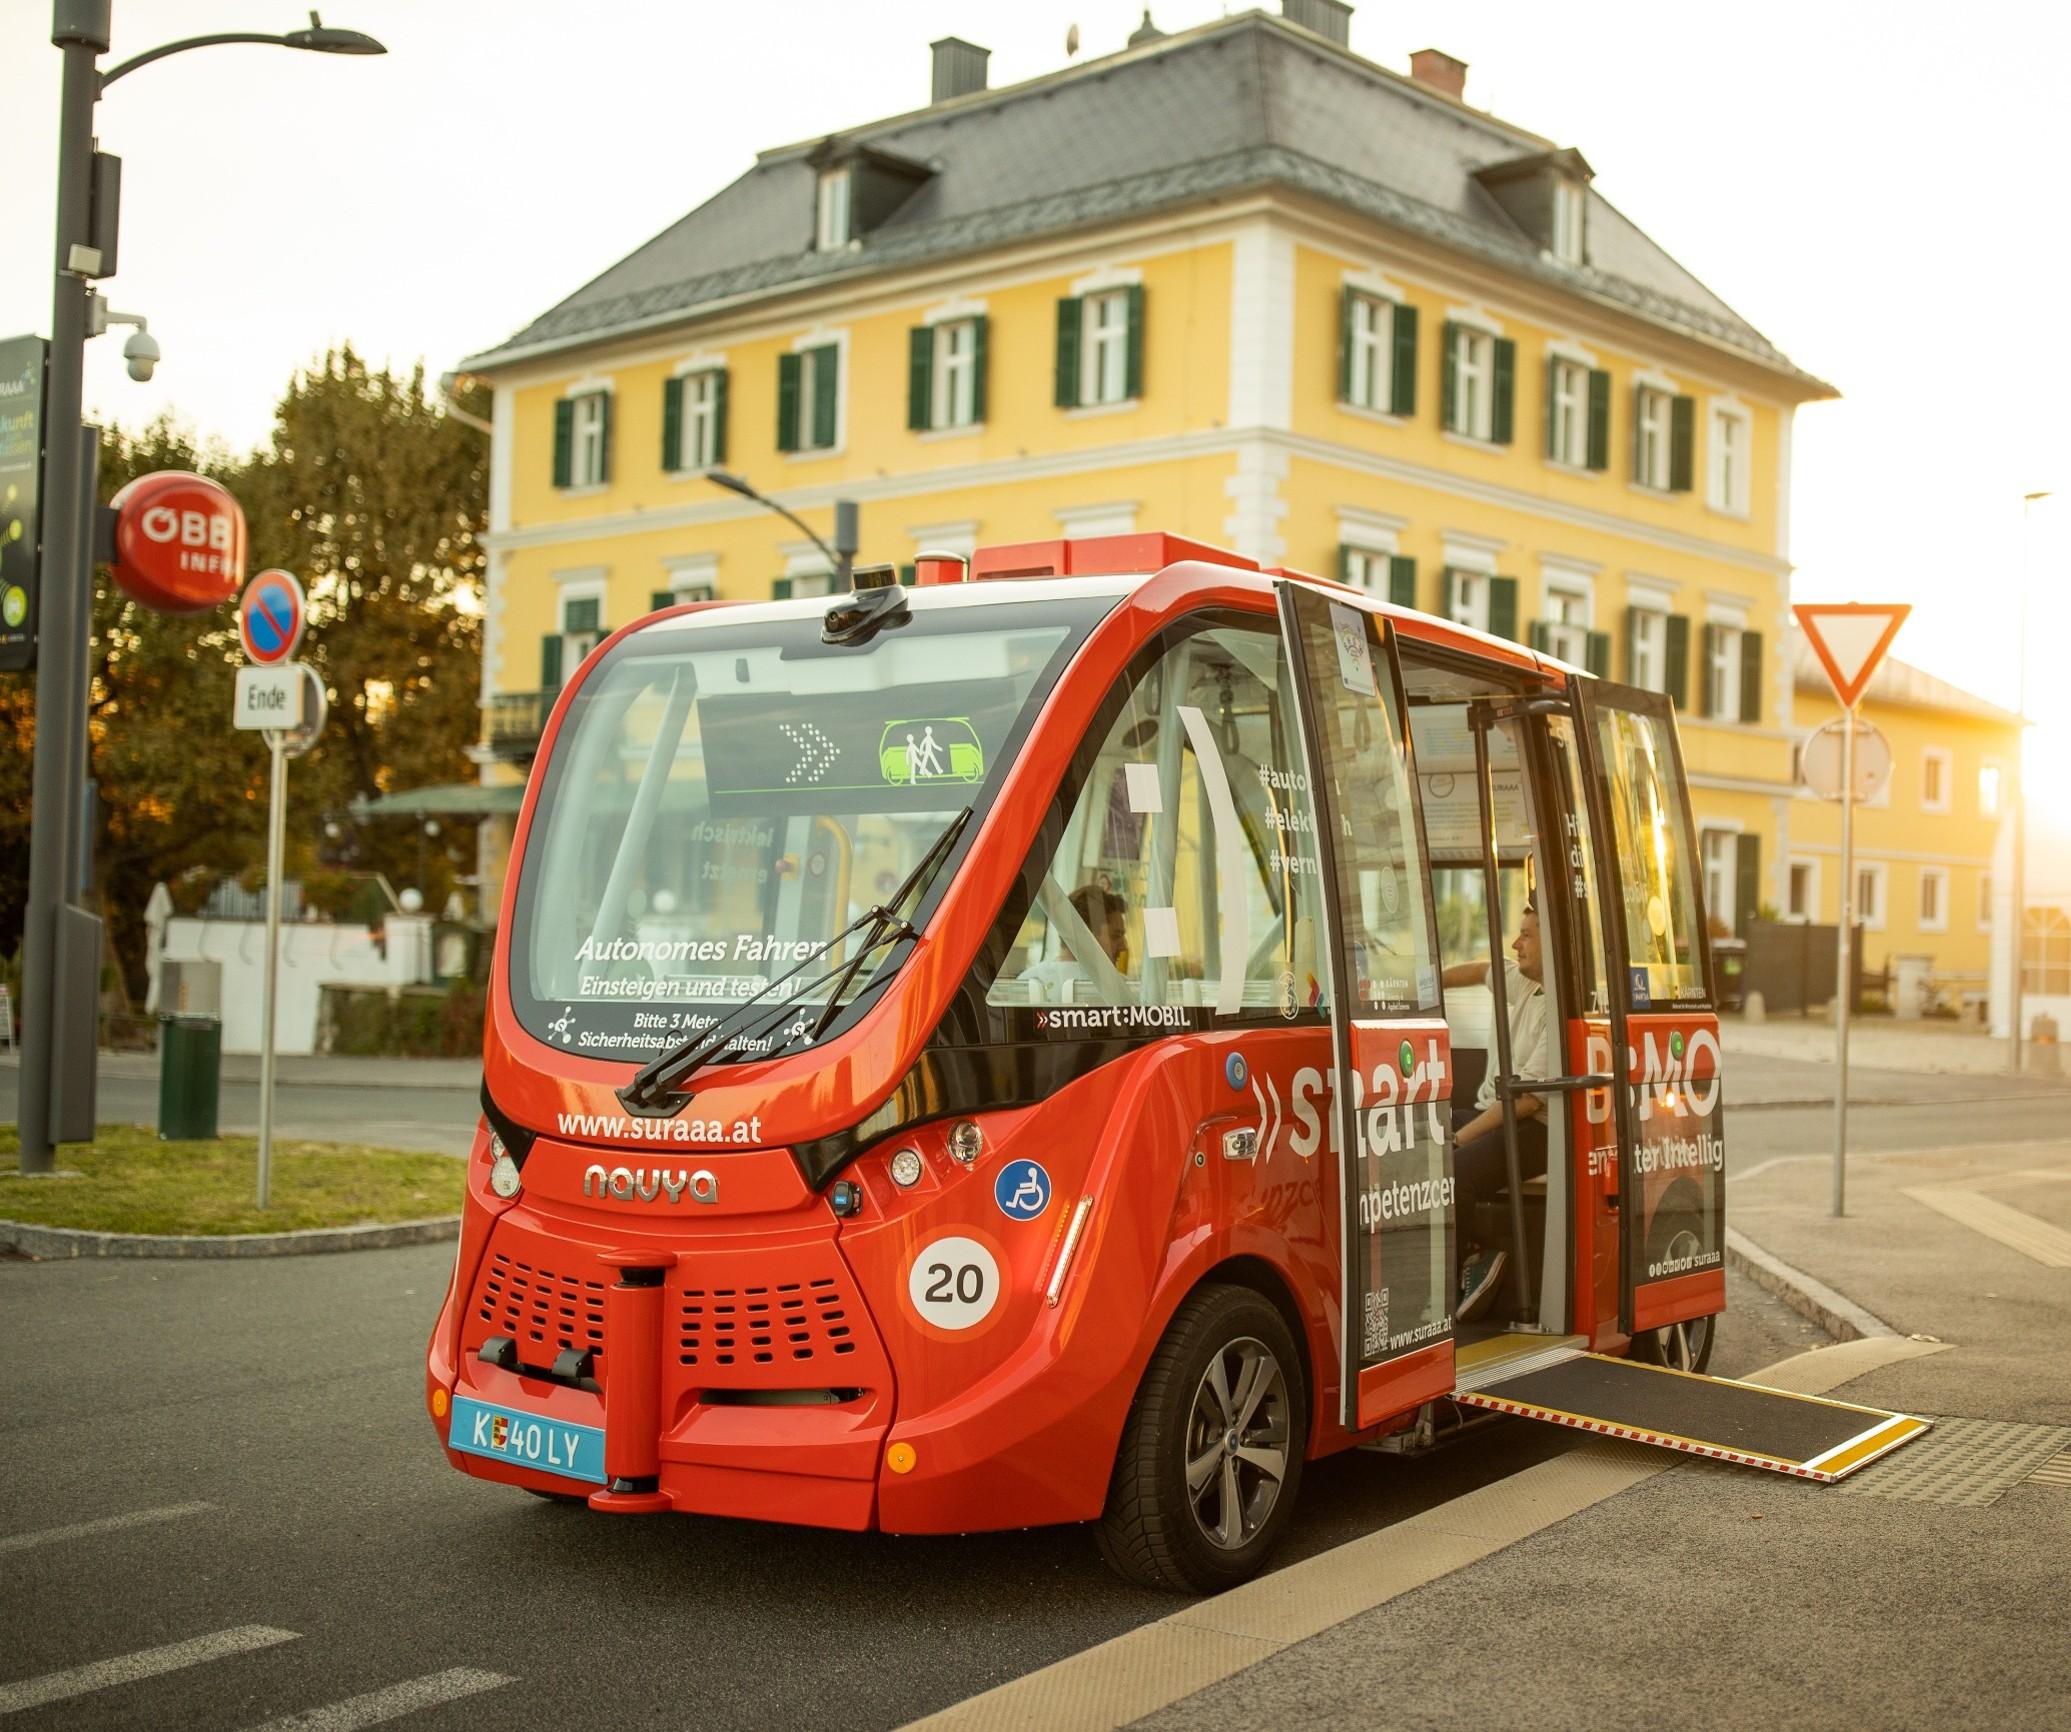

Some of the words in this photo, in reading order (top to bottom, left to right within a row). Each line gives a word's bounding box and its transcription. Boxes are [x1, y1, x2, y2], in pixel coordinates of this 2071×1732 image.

[142, 506, 232, 552] ÖBB
[248, 686, 286, 710] Ende
[1260, 764, 1306, 791] #auto
[1265, 806, 1316, 832] #elekt
[1270, 849, 1317, 874] #vern
[574, 935, 727, 962] Autonomes
[732, 935, 829, 962] Fahren
[579, 976, 679, 1002] Einsteigen
[685, 979, 727, 997] und
[730, 978, 801, 1000] testen!
[634, 1012, 667, 1028] Bitte
[672, 1013, 680, 1028] 3
[721, 1034, 773, 1051] alten!
[557, 1112, 762, 1143] www.suraaa.at
[583, 1164, 719, 1204] navya
[1694, 1251, 1720, 1267] suraaa
[925, 1263, 984, 1304] 20
[1389, 1313, 1452, 1351] www.suraaa.at
[473, 1410, 491, 1447] K
